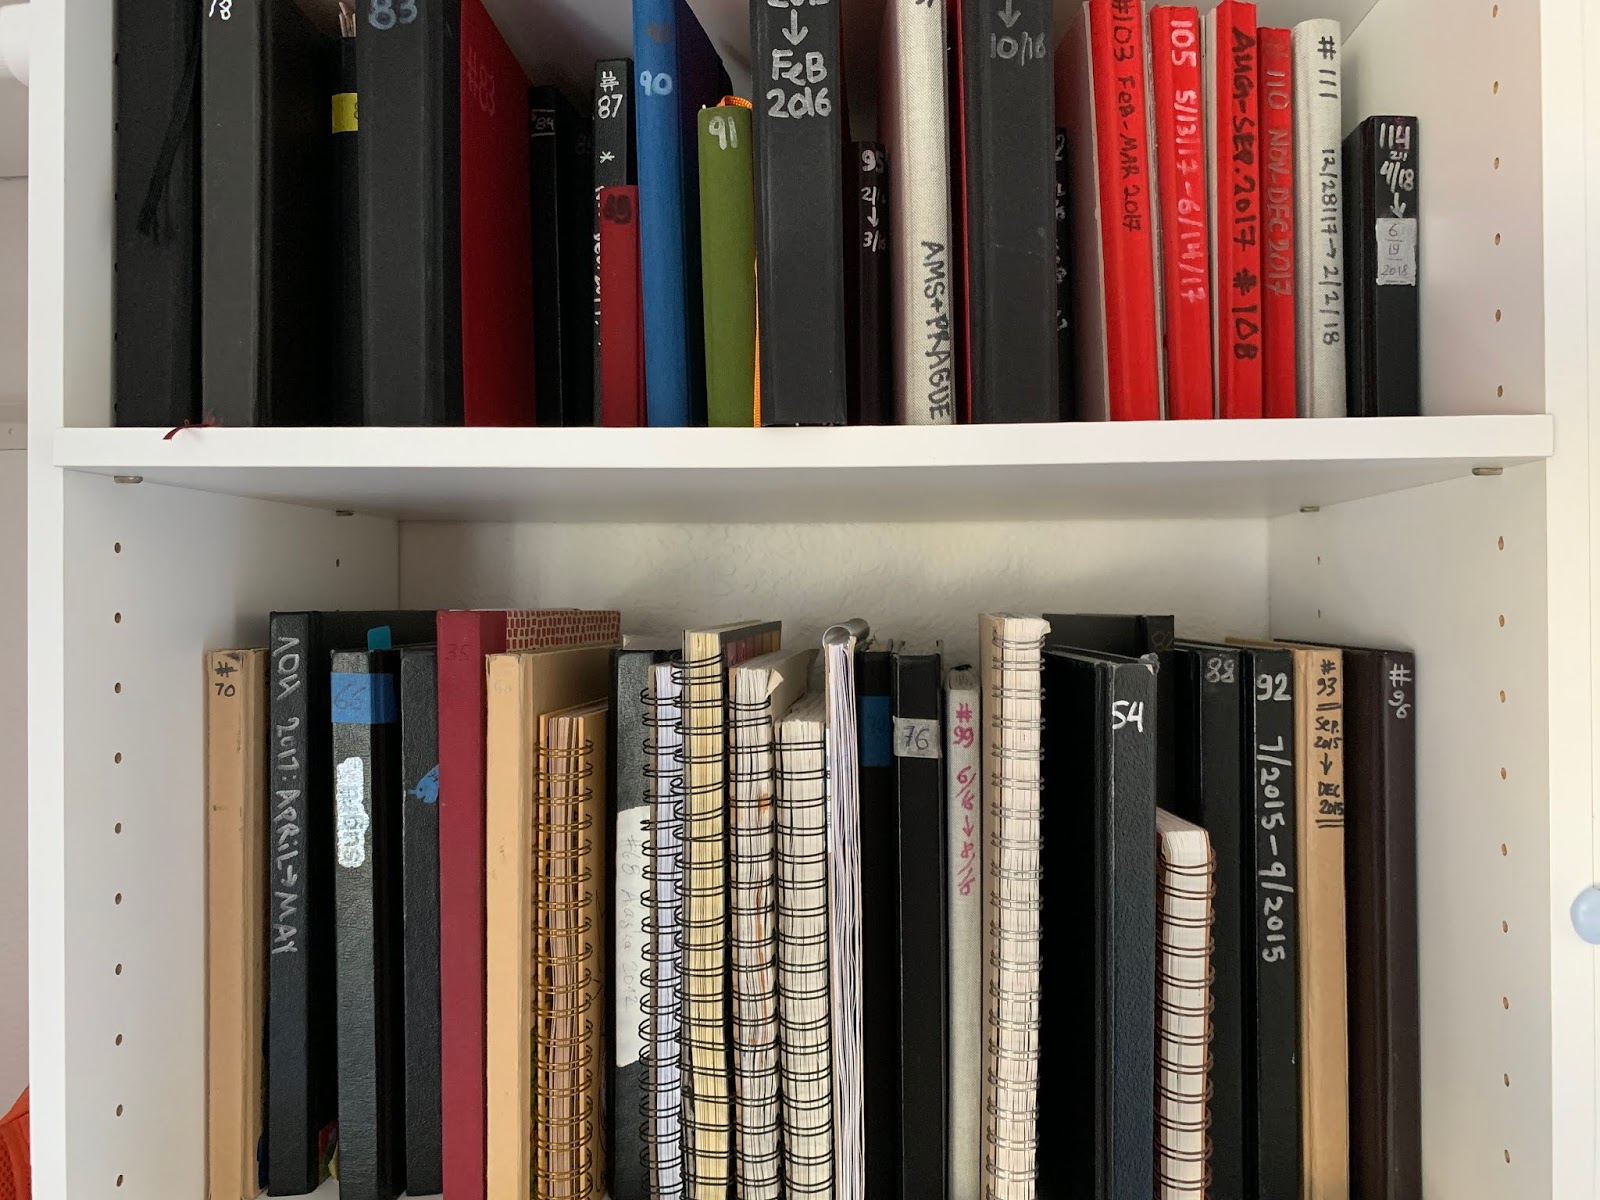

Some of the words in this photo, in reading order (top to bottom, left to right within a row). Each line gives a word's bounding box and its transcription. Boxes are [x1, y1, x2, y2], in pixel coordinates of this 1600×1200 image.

[990, 31, 1046, 66] 10/16
[1170, 20, 1197, 67] 105
[600, 70, 619, 92] #
[639, 69, 673, 97] 90
[598, 93, 623, 119] 87
[766, 86, 832, 119] 2016
[708, 115, 738, 150] 91
[1379, 122, 1411, 150] 114
[1122, 184, 1142, 232] 2017
[1380, 264, 1409, 276] 2018
[214, 682, 236, 698] 70
[1256, 673, 1292, 701] 92
[955, 702, 973, 723] #
[1111, 700, 1144, 733] 54
[903, 724, 929, 750] 76
[953, 726, 975, 749] 99
[1318, 781, 1340, 798] DEC
[1319, 800, 1344, 815] 2015
[271, 891, 298, 956] MAY
